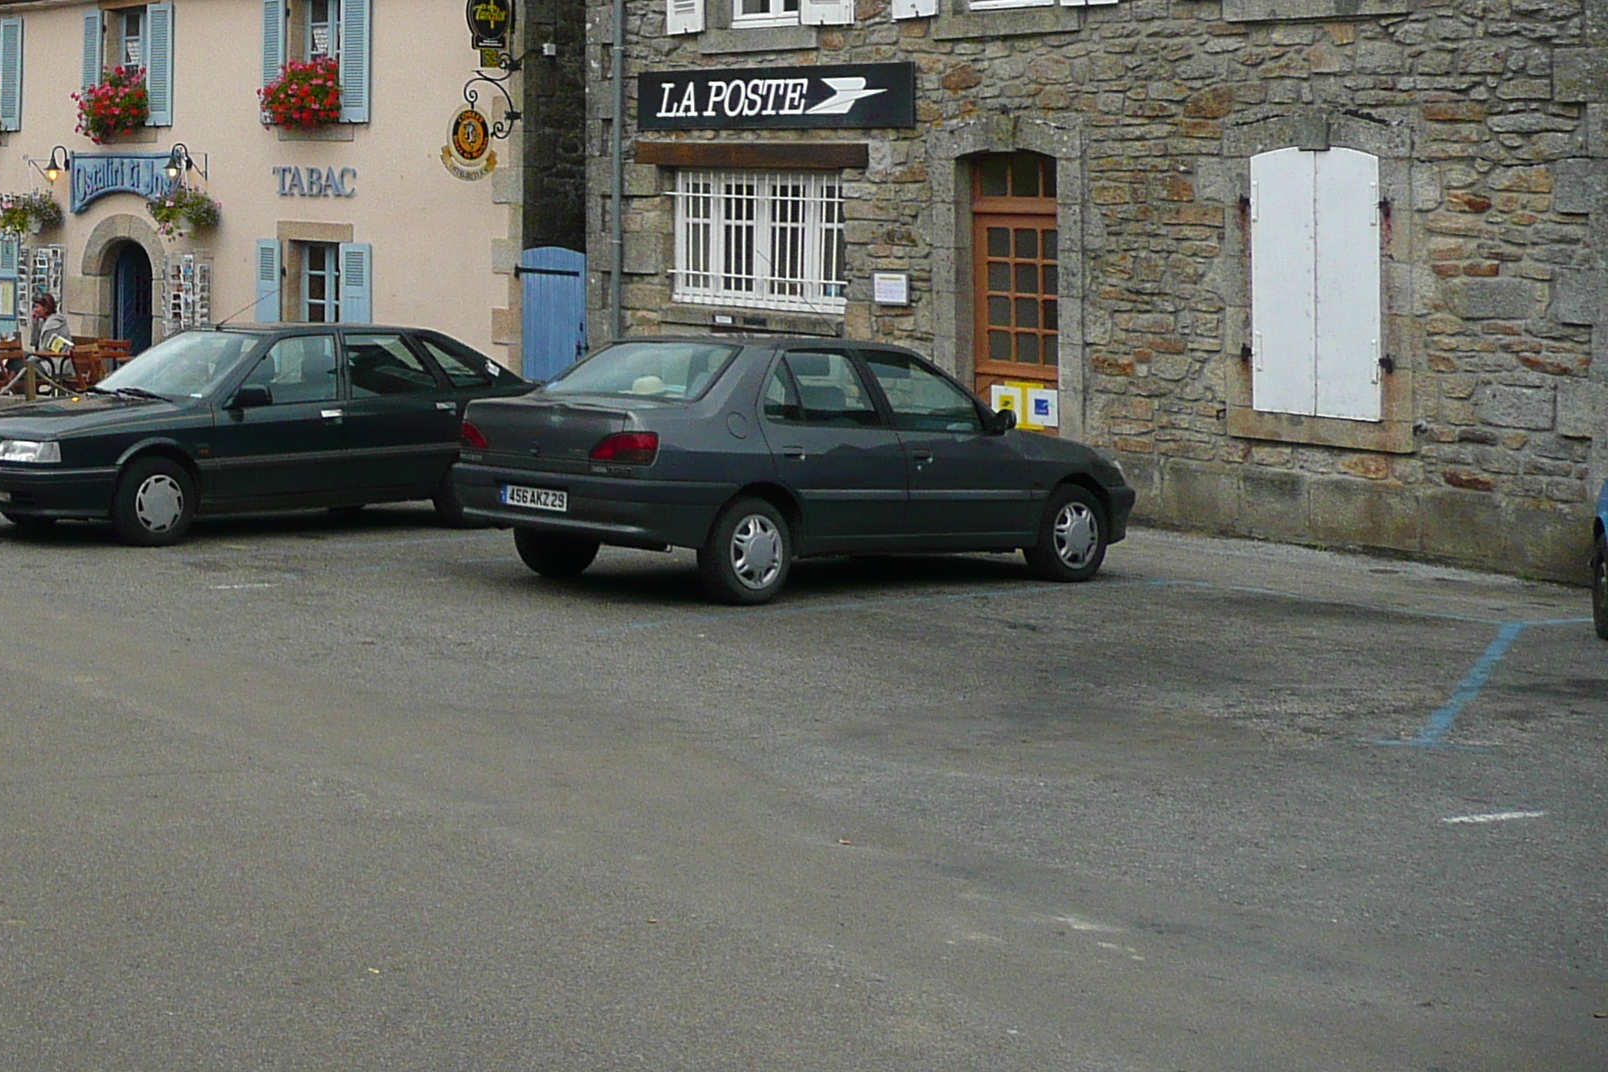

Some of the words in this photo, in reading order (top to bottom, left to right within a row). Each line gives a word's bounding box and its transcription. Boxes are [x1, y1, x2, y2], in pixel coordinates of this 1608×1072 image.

[656, 82, 698, 117] LA
[703, 78, 808, 116] POSTE
[272, 166, 357, 198] TABAC
